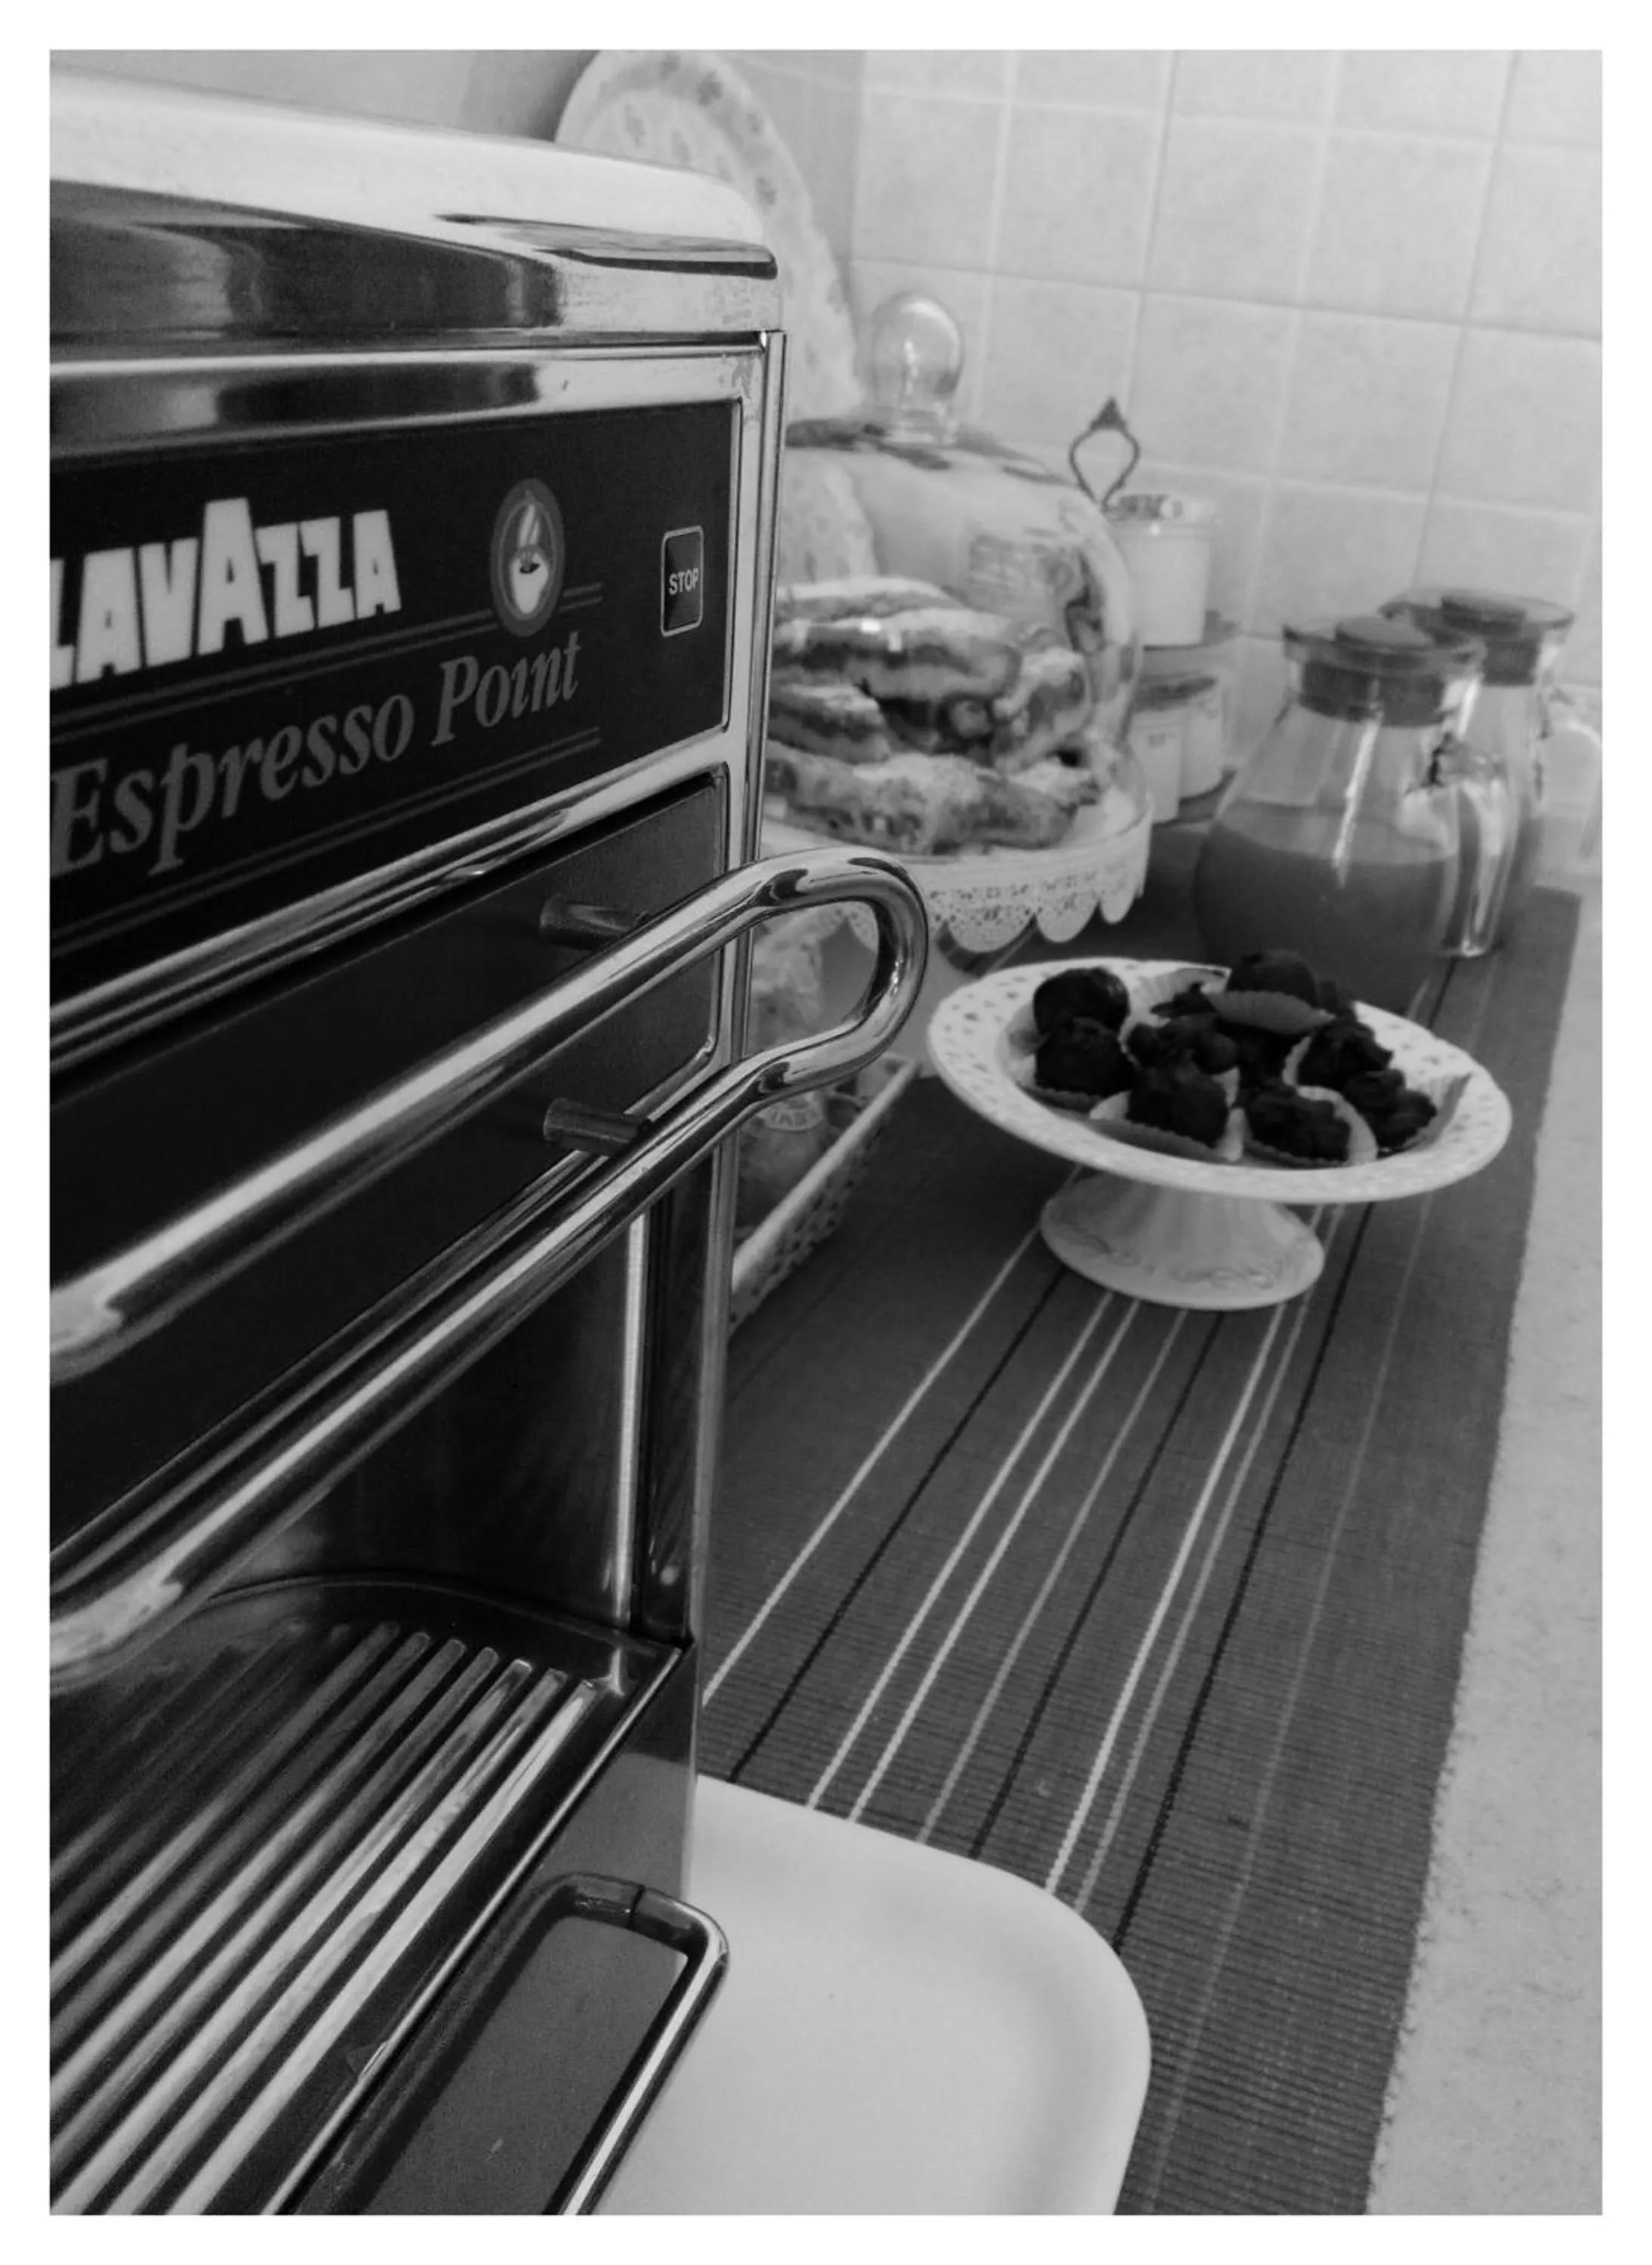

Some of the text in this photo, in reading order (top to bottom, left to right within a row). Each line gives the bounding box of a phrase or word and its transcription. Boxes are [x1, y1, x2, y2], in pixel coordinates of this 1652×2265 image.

[668, 567, 699, 595] STOP
[50, 631, 581, 878] Espresso Point
